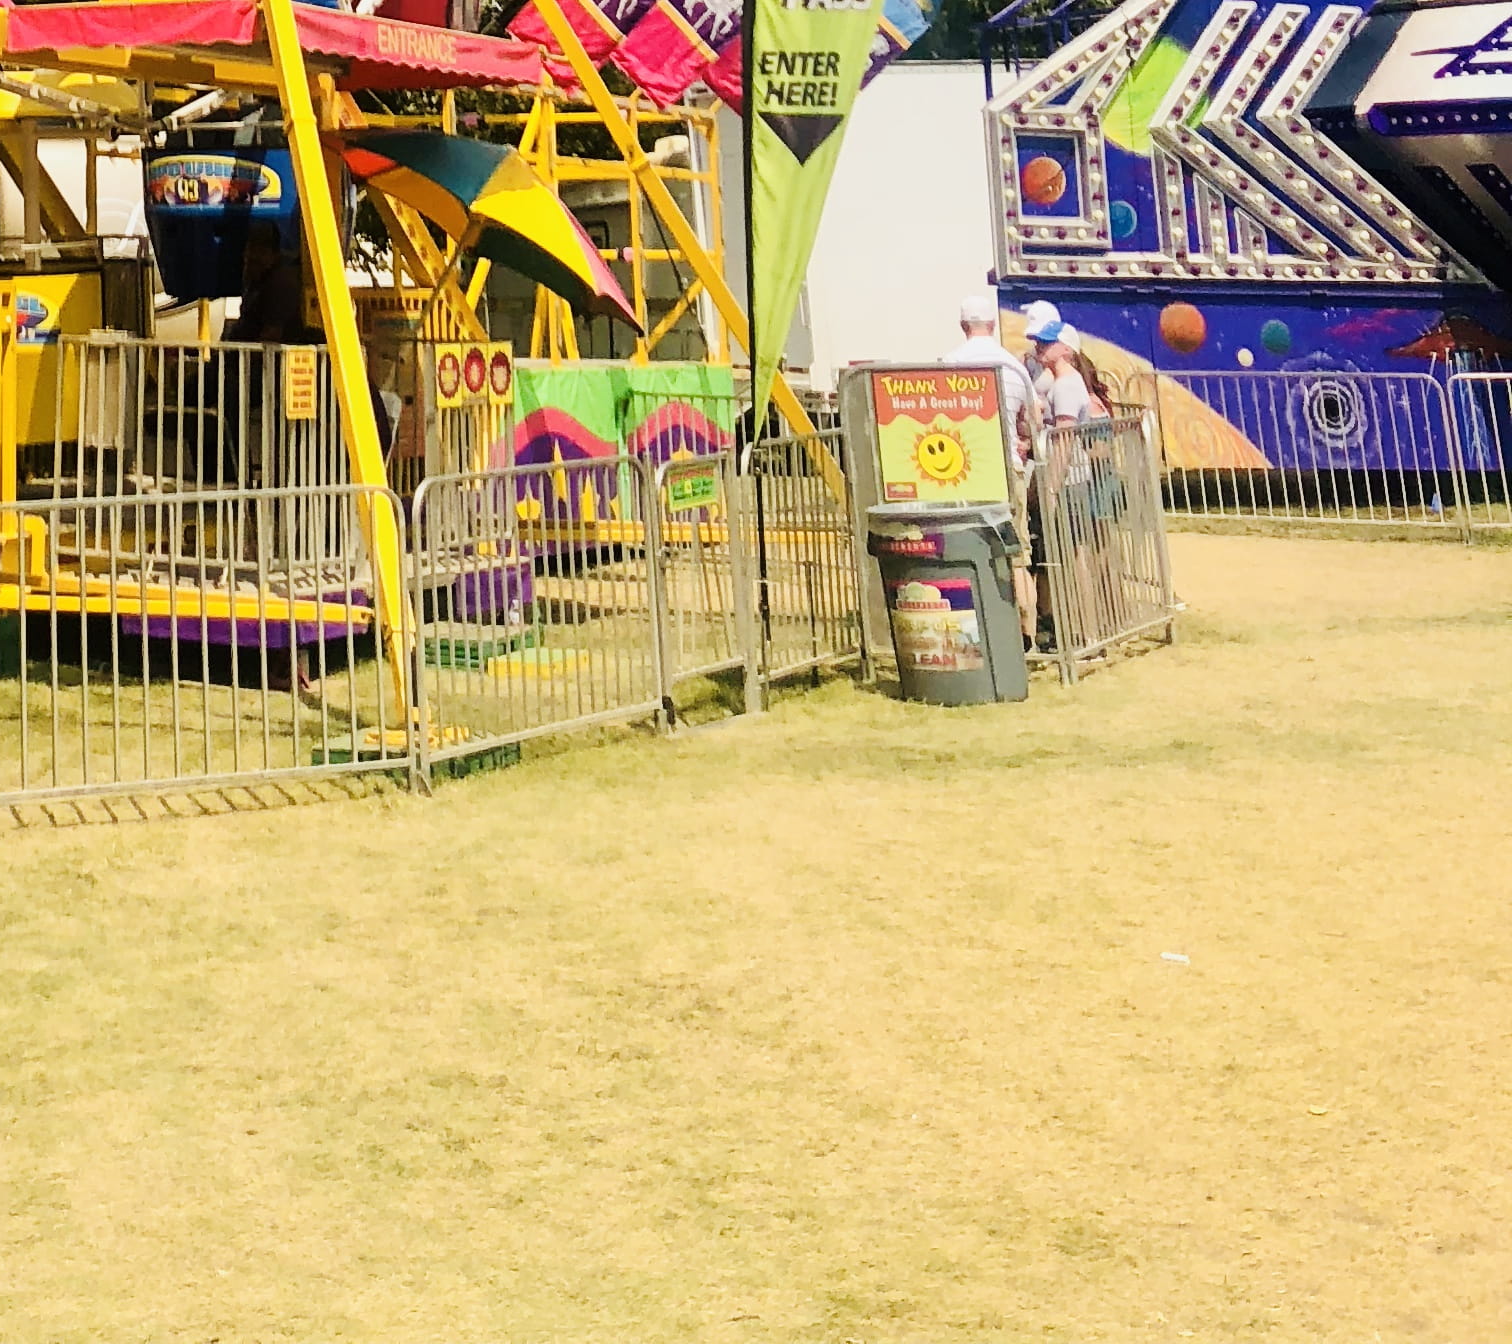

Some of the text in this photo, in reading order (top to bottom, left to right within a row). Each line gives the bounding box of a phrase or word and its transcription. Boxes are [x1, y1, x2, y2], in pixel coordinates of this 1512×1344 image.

[759, 50, 841, 77] ENTER
[764, 80, 838, 106] HERE!
[881, 373, 987, 396] THANK YOU!
[892, 395, 984, 411] Have A Great Day!
